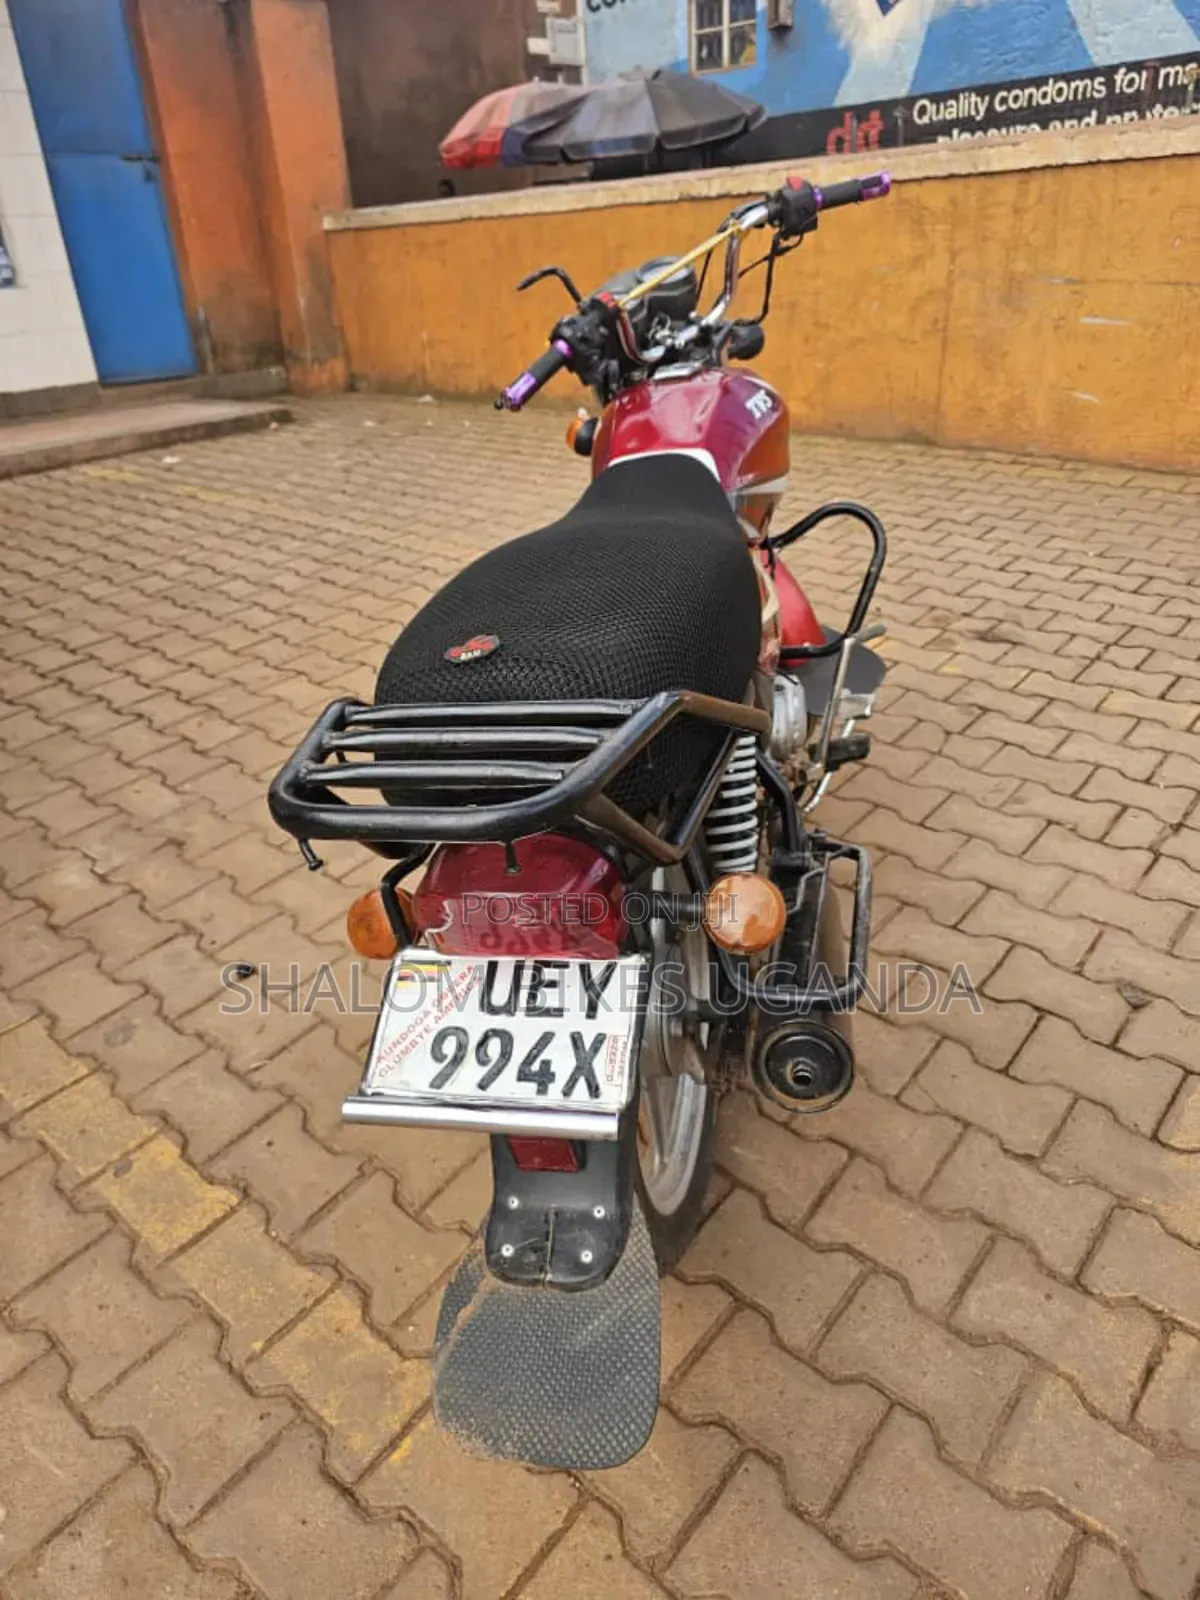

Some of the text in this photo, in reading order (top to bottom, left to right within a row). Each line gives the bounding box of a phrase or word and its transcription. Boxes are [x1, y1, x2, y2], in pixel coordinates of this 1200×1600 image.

[913, 91, 990, 125] Quality
[994, 77, 1108, 112] condoms
[479, 959, 617, 1020] UEY
[428, 1026, 607, 1099] 994X
